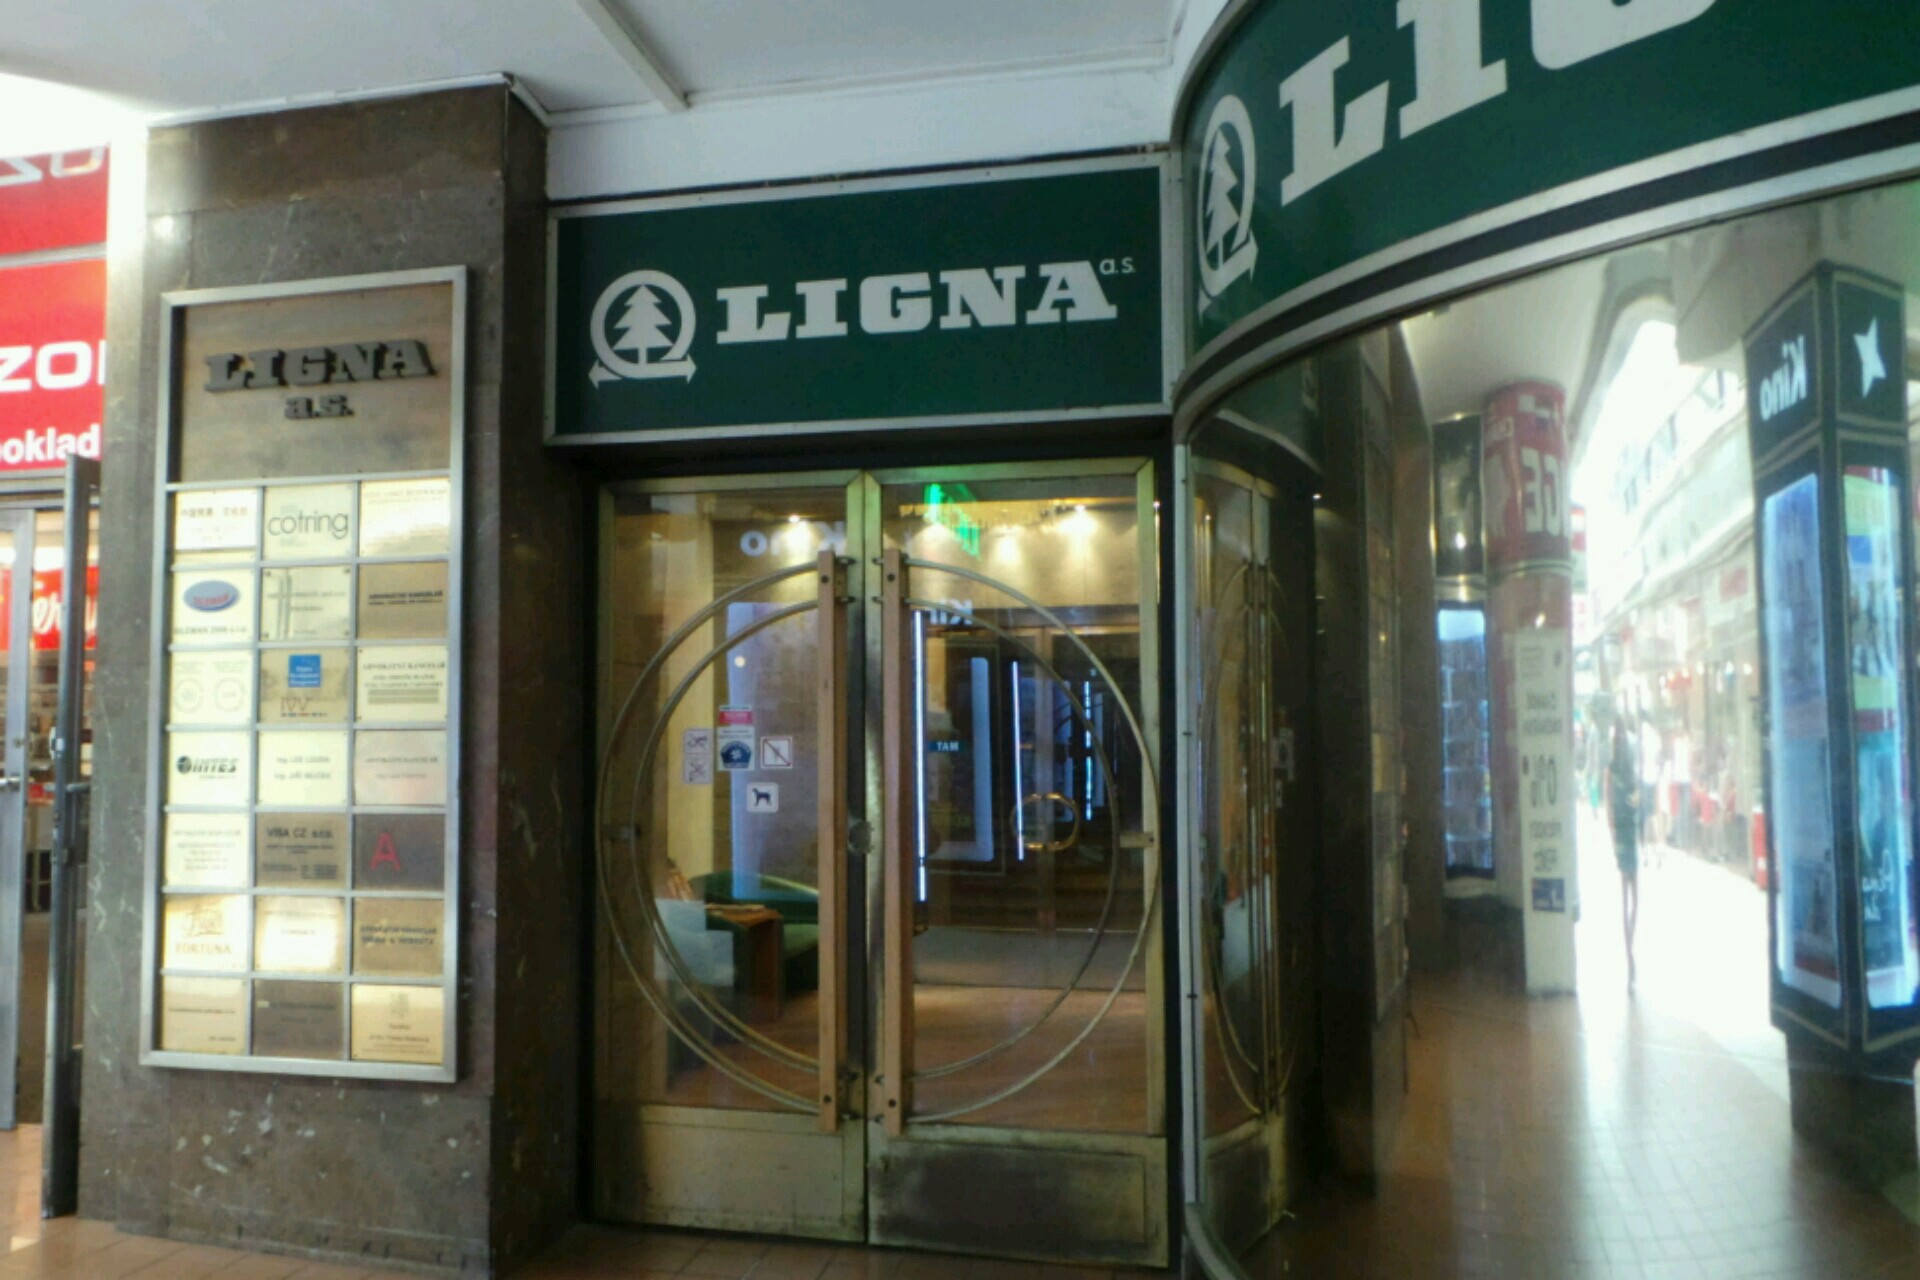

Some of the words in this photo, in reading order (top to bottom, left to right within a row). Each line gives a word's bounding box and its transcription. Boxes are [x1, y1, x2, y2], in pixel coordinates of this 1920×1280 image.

[717, 261, 1117, 344] LIGNA
[205, 339, 437, 391] LIGNA
[0, 423, 101, 465] oklad
[268, 511, 348, 540] cotring
[370, 832, 401, 871] A
